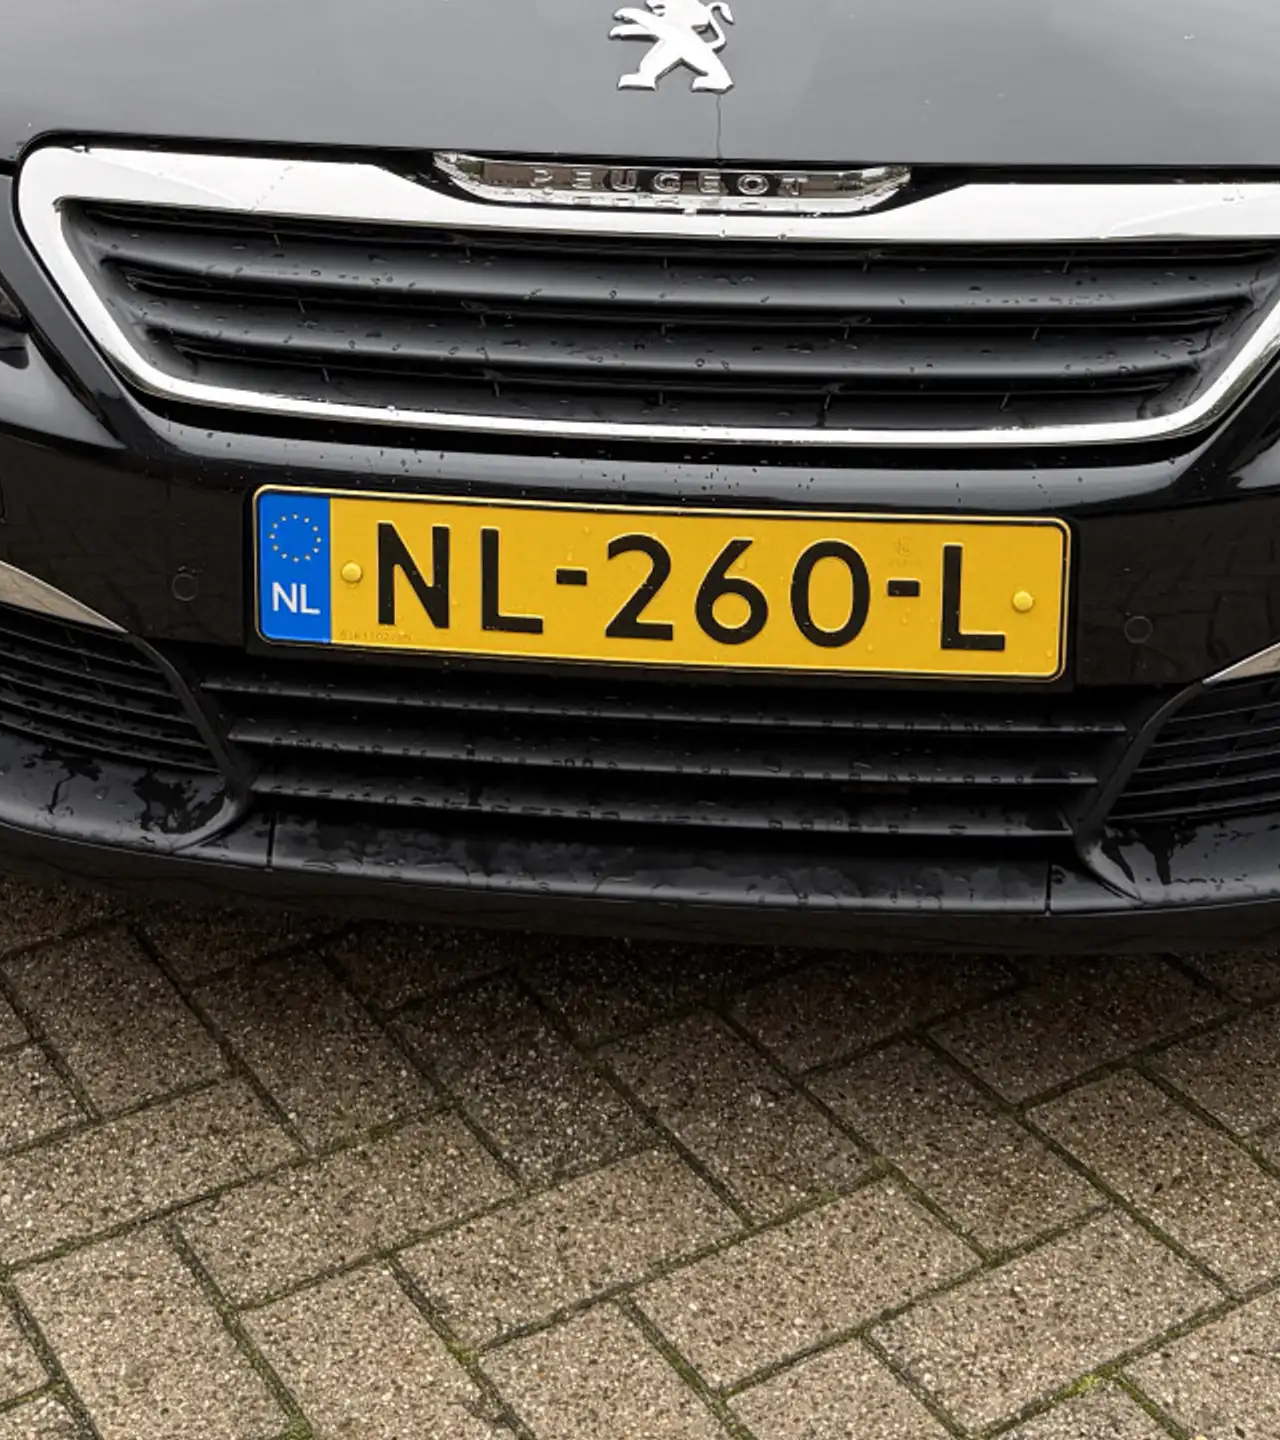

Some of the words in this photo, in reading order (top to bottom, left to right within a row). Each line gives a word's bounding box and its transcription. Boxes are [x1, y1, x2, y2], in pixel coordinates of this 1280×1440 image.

[529, 168, 810, 197] PEUGEOT
[272, 581, 320, 615] NL
[376, 522, 1006, 652] NL-260-L
